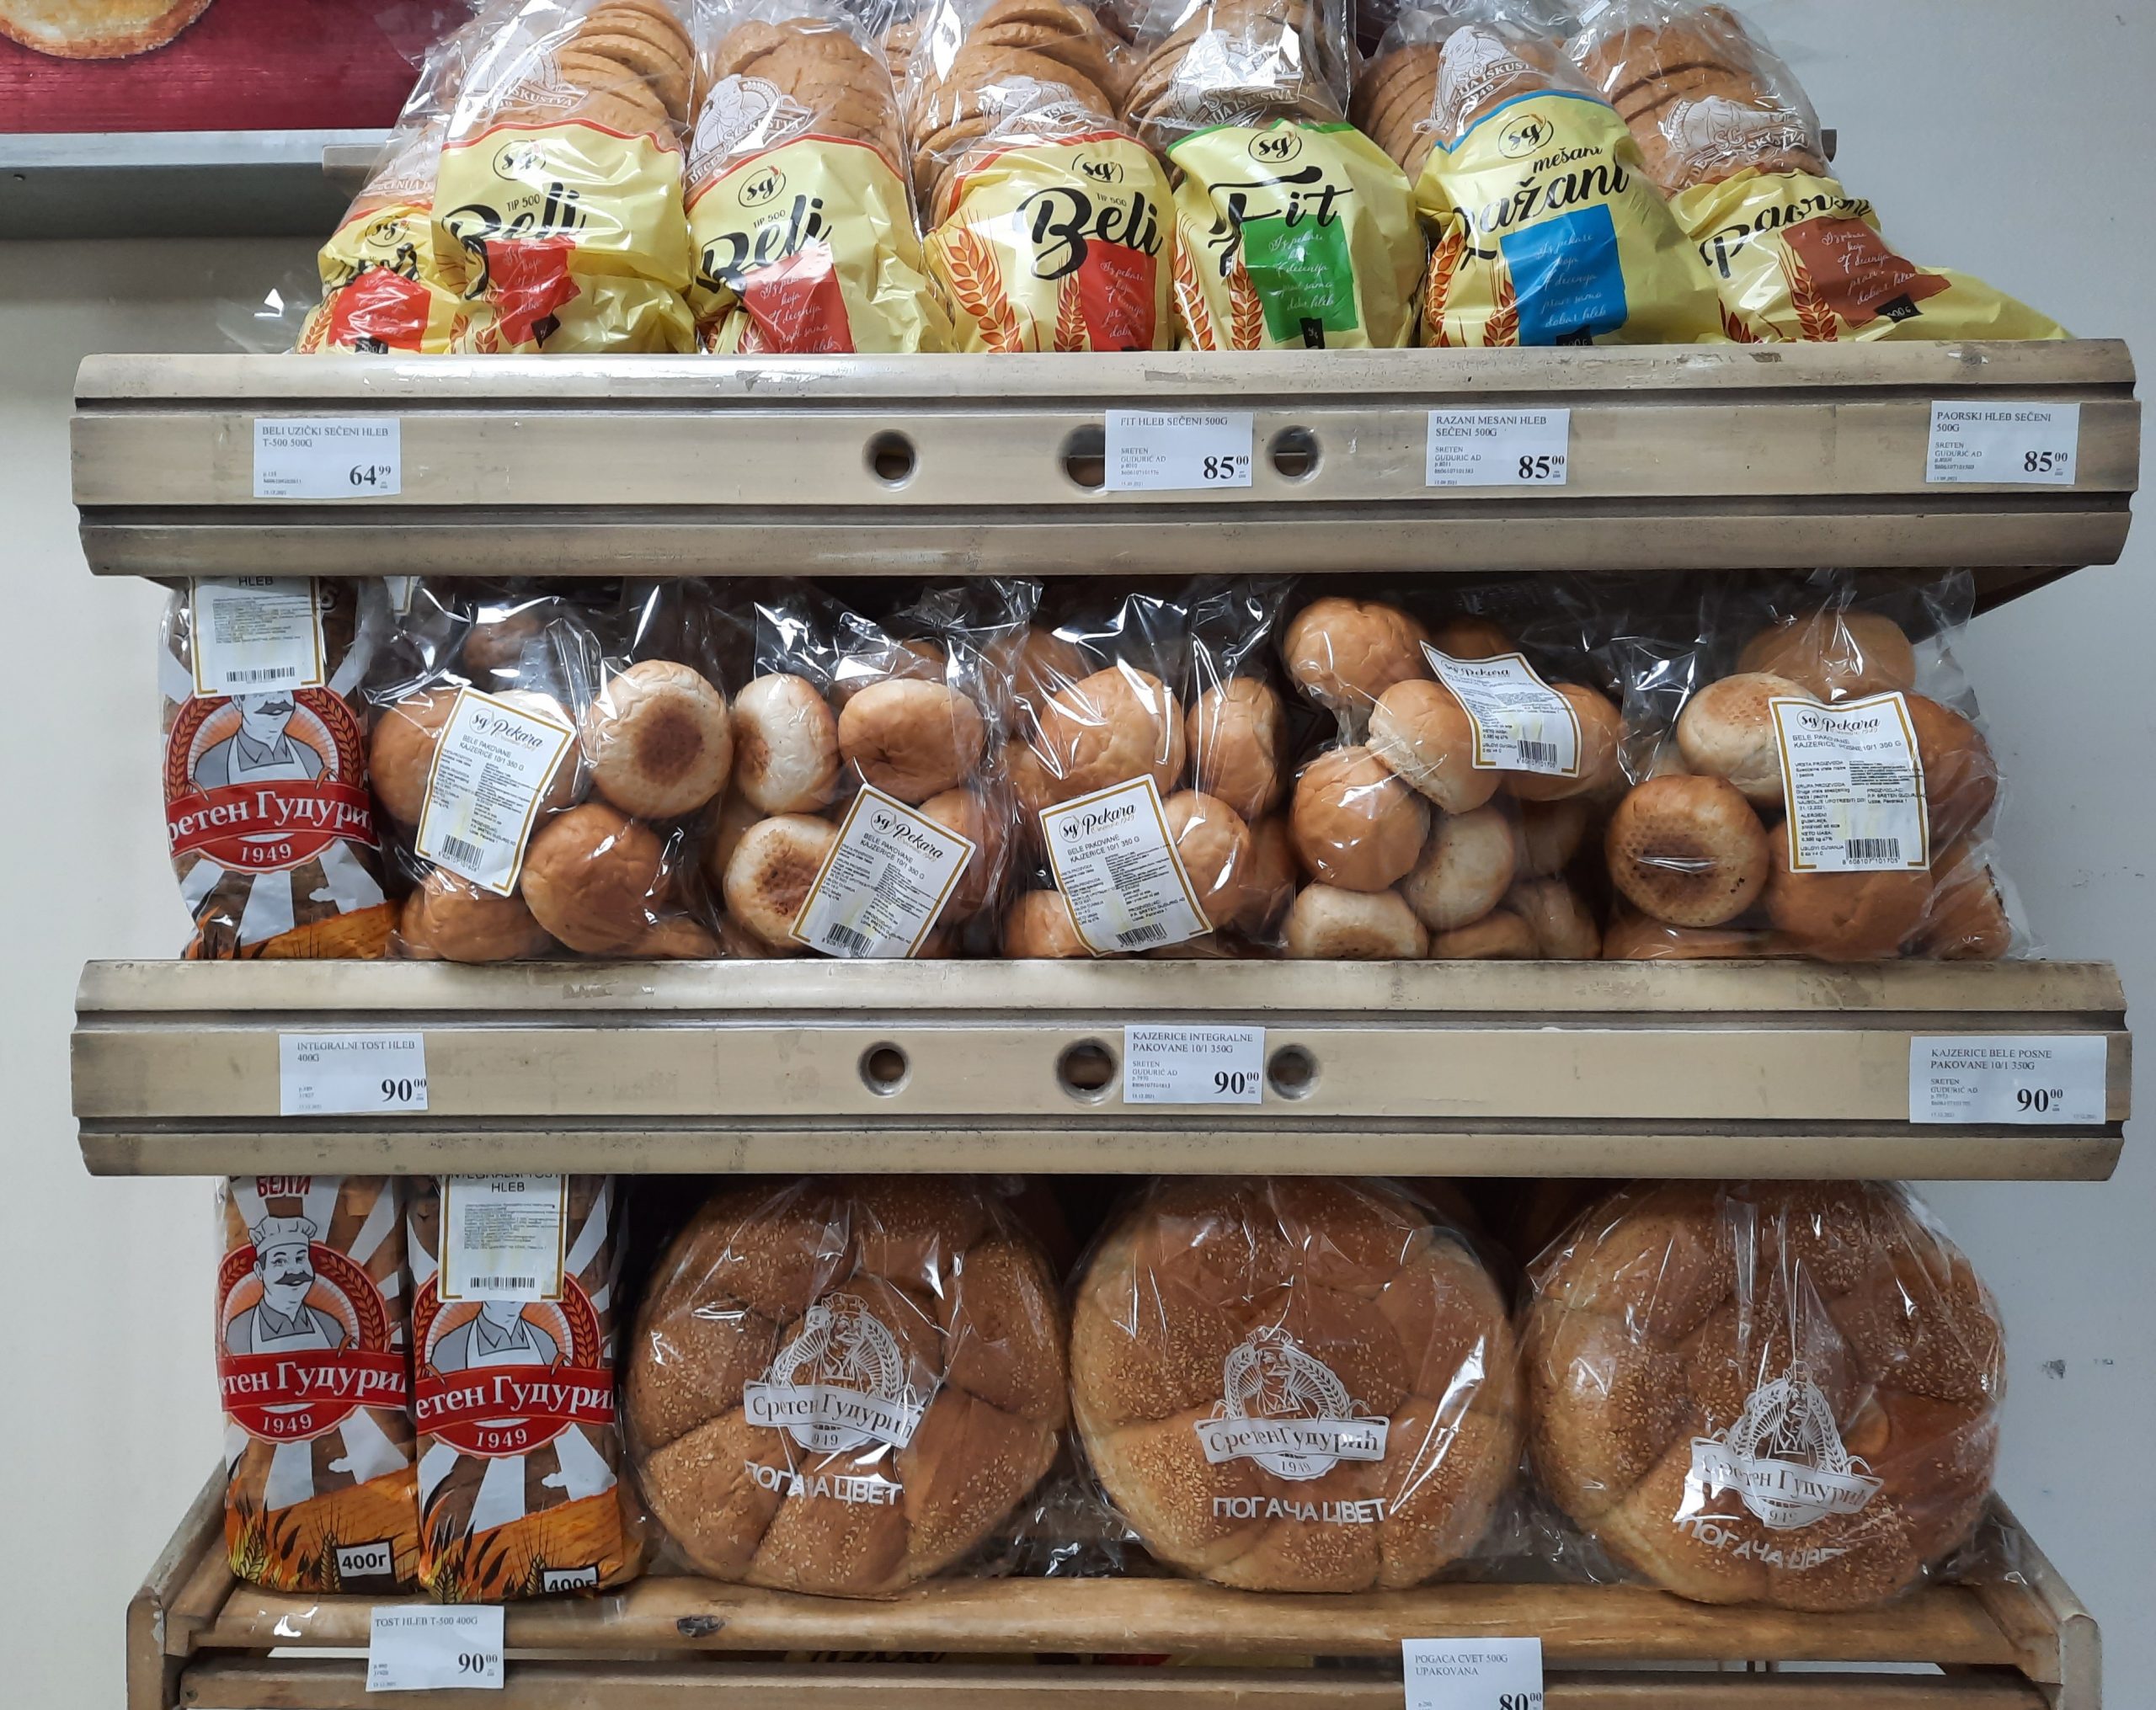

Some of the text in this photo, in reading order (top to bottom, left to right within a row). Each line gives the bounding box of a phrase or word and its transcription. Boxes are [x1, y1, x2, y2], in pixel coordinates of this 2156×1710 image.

[1259, 135, 1290, 157] sg
[1533, 146, 1604, 173] mešani
[746, 173, 776, 200] sg
[507, 194, 540, 212] TIP 500
[753, 210, 786, 228] TIP 500
[1208, 166, 1353, 277] Fit
[1012, 187, 1163, 280] Beli
[1838, 255, 1851, 274] 7
[1310, 295, 1334, 308] hleb
[1121, 415, 1228, 426] FIT HLEB SEČENI 500G
[1436, 416, 1547, 425] RAZANI MESANI HLEB
[1937, 411, 2051, 422] PAORSKI HLEB SEČENI
[263, 425, 388, 436] BELI UZIČKI SEČENI HLEB
[1436, 426, 1497, 437] SEČENI 500G
[1936, 424, 1960, 433] 500G
[263, 439, 312, 447] T-500 500G
[238, 577, 274, 586] HLEB
[472, 714, 543, 748] sg Pekara
[1801, 716, 1880, 732] sg Pekara
[459, 743, 493, 759] KAJZERICE
[1793, 740, 1835, 748] KAJZERICE
[255, 791, 371, 829] Гудури
[1064, 803, 1136, 839] sg Pekara
[873, 814, 943, 859] sg Pekara
[241, 843, 291, 863] 1949
[860, 839, 895, 860] KAJZERICE
[863, 834, 914, 863] BELE PAKOVANE
[1070, 849, 1106, 863] KAJZERICE
[1107, 843, 1120, 852] 10/1
[297, 1041, 415, 1051] INTEGRALNI TOST HLEB
[1133, 1032, 1253, 1042] KAJZERICE INTEGRALNE
[1133, 1043, 1233, 1053] PAKOVANE 10/1 350G
[1931, 1049, 2052, 1058] KAJZERICE BELE POSNE
[297, 1053, 319, 1063] 400G
[1930, 1061, 2035, 1070] PAKOVANE 10/1 350G
[491, 1182, 525, 1192] HLEB
[493, 1375, 614, 1414] Гудури
[752, 1392, 819, 1421] Сретен
[262, 1414, 312, 1433] 1949
[476, 1428, 527, 1448] 1949
[1209, 1428, 1275, 1453] Сретен
[834, 1476, 904, 1505] ЦВЕТ
[1213, 1497, 1387, 1527] ПОГАЧА ЦВЕТ
[375, 1617, 478, 1627] TOST HLEB T-500 400G
[1415, 1654, 1508, 1664] POGACA CVET 500G
[1416, 1667, 1479, 1676] UPAKOVANA
